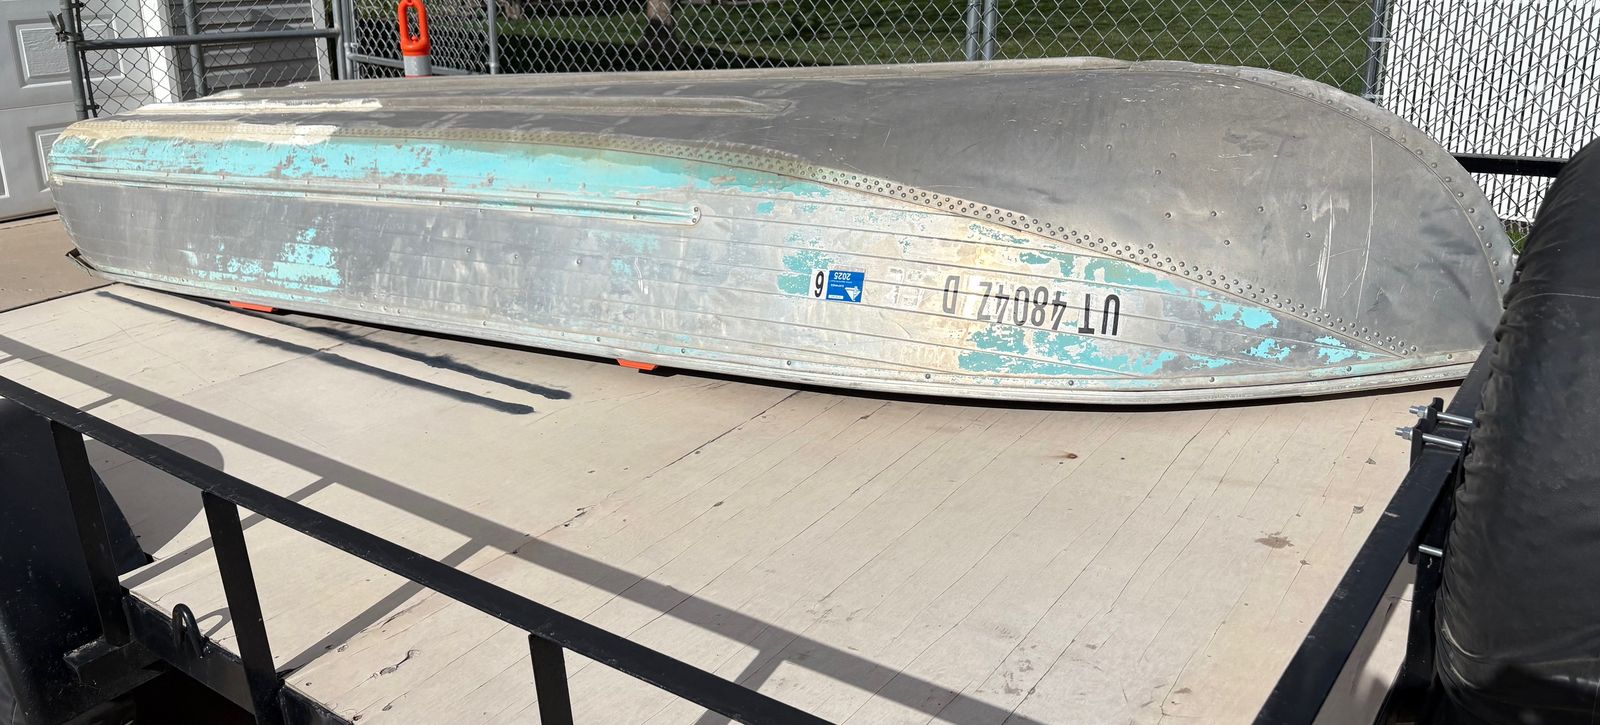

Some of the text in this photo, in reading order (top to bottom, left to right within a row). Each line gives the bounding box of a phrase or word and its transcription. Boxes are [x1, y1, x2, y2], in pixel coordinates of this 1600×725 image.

[814, 270, 824, 298] 6
[833, 271, 851, 281] 2025
[942, 275, 960, 315] D
[1078, 293, 1121, 336] UT
